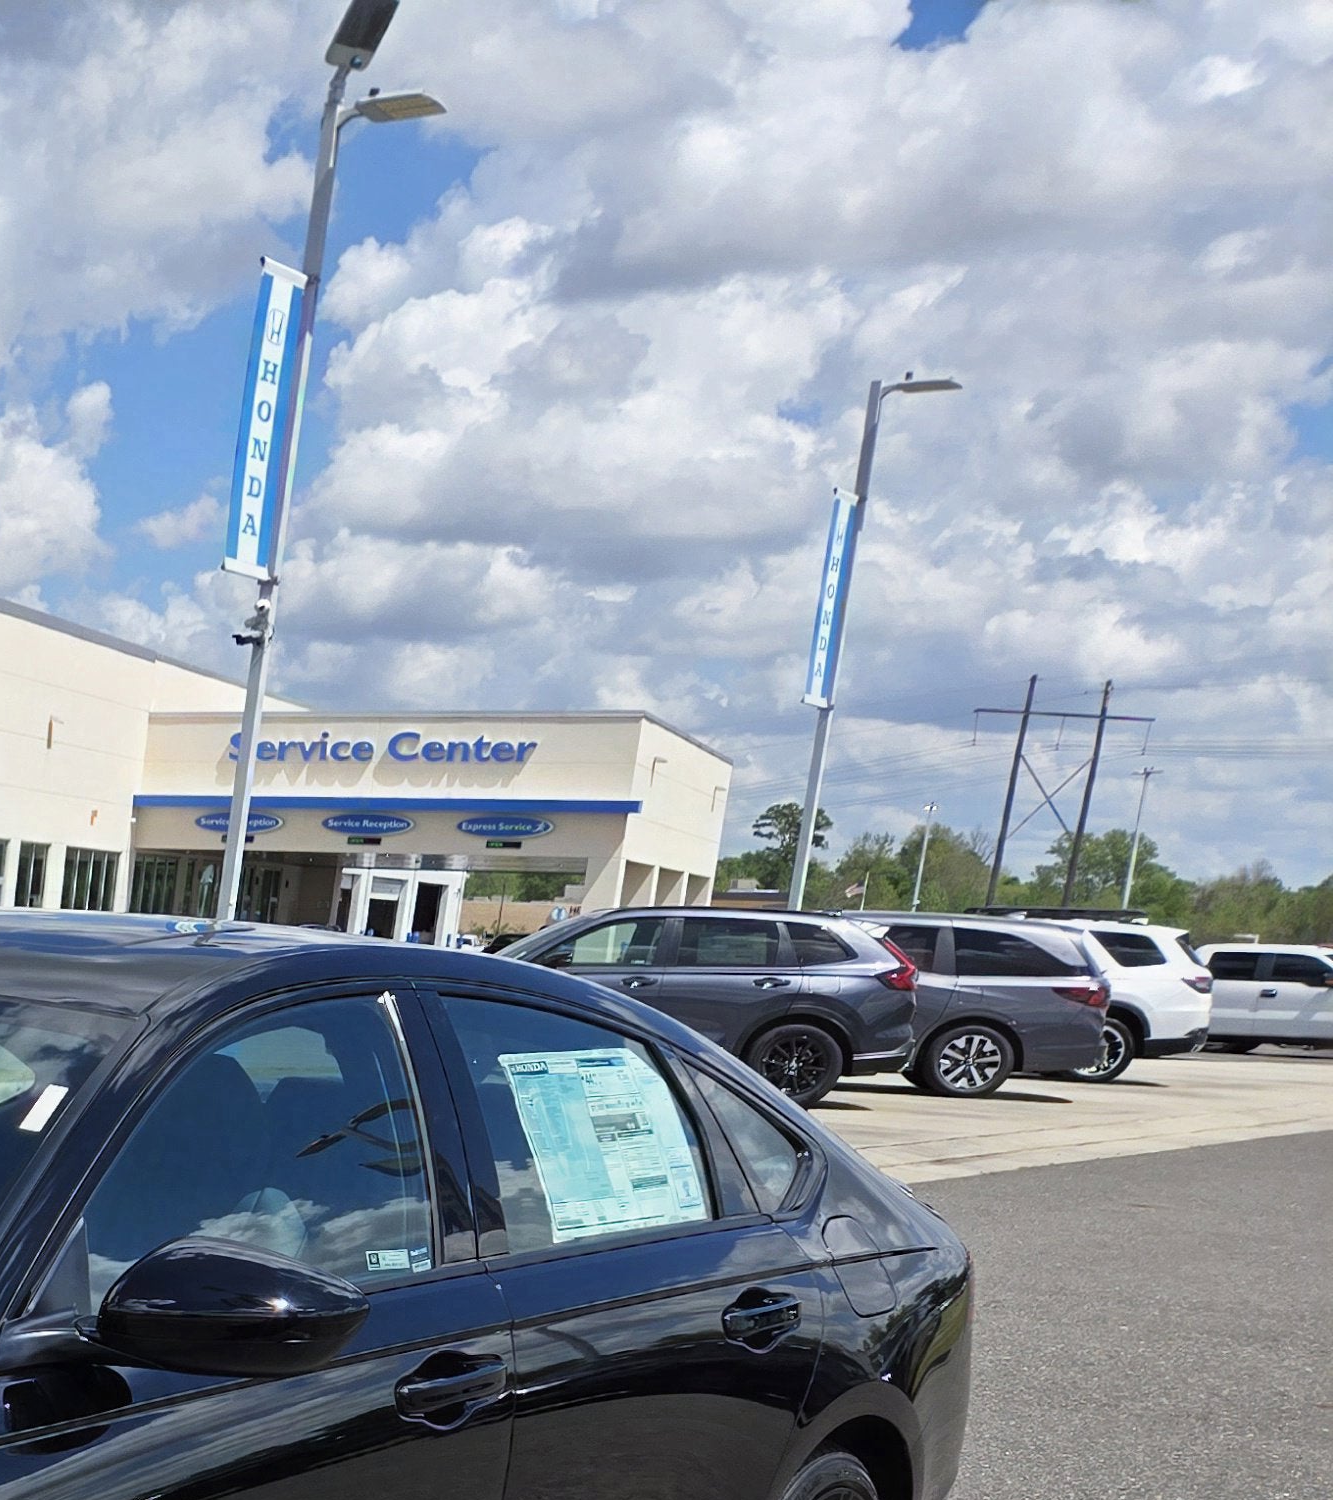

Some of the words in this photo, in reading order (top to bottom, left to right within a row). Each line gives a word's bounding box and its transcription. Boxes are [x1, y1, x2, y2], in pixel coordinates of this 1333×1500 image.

[241, 359, 278, 537] HONDA
[814, 556, 840, 678] HONDA
[387, 731, 538, 763] Center
[327, 818, 360, 828] Service
[362, 818, 408, 830] Reception
[461, 821, 496, 832] Express
[498, 822, 532, 831] Service
[515, 1061, 548, 1073] HONDA
